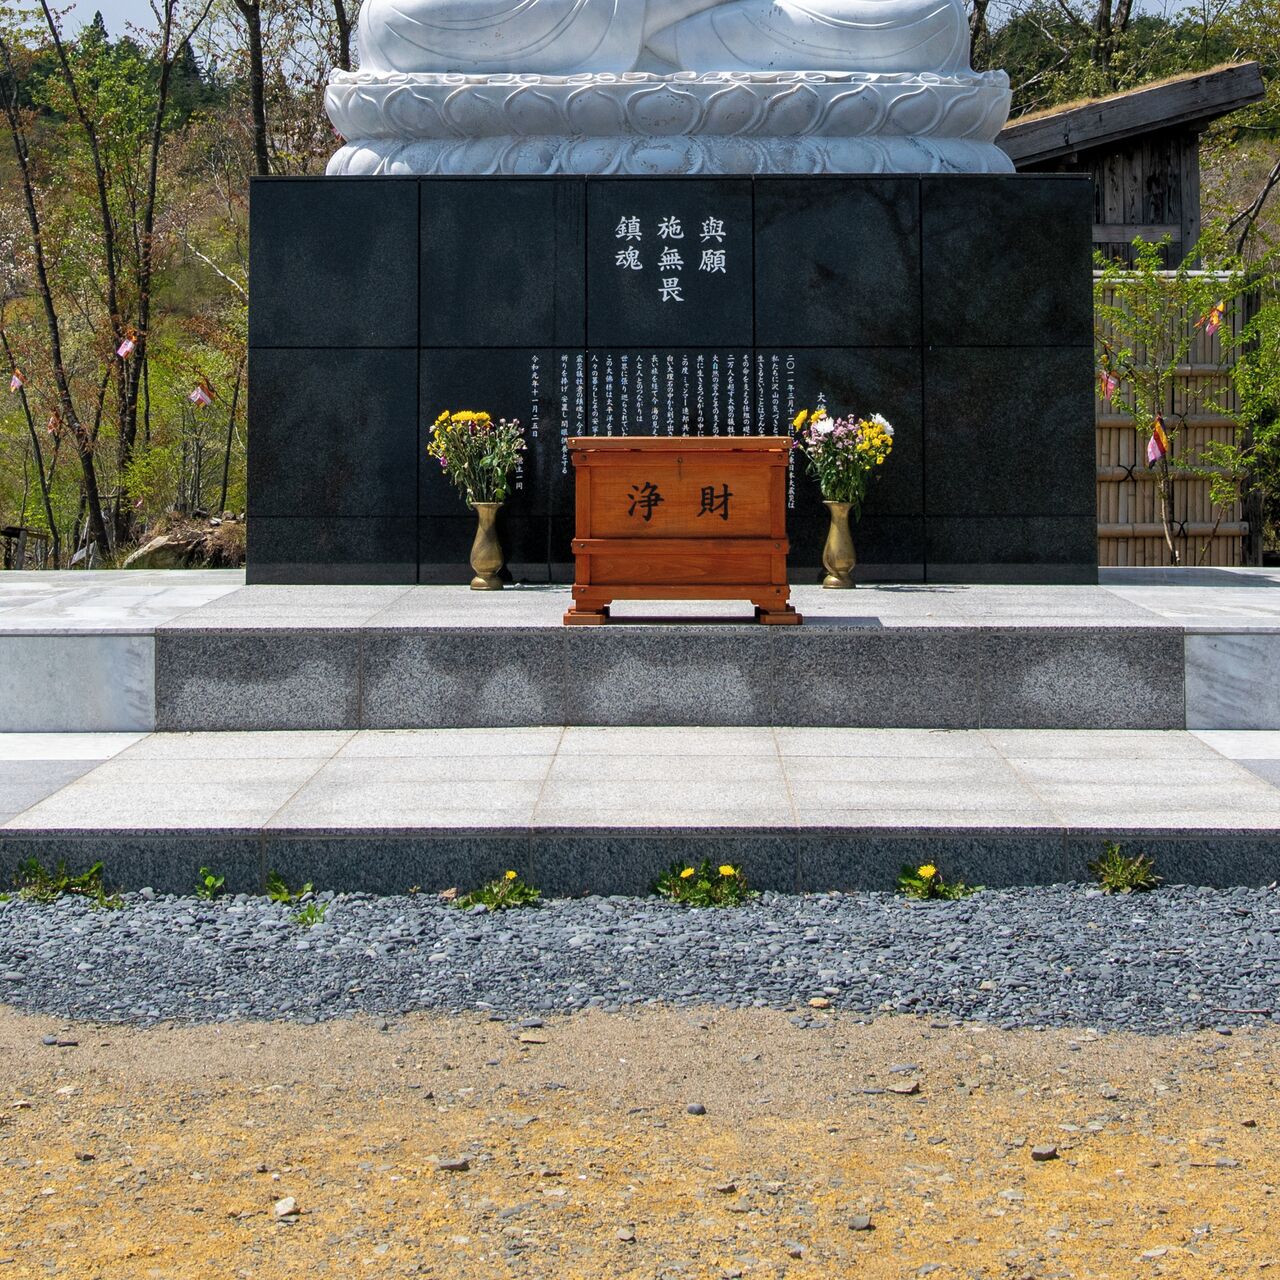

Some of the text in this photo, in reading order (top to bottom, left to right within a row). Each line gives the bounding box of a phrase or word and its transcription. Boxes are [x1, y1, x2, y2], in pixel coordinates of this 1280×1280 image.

[614, 215, 644, 271] 鎮魂
[656, 215, 685, 303] 施無畏
[698, 215, 727, 274] 與願
[627, 481, 734, 522] 浄財
